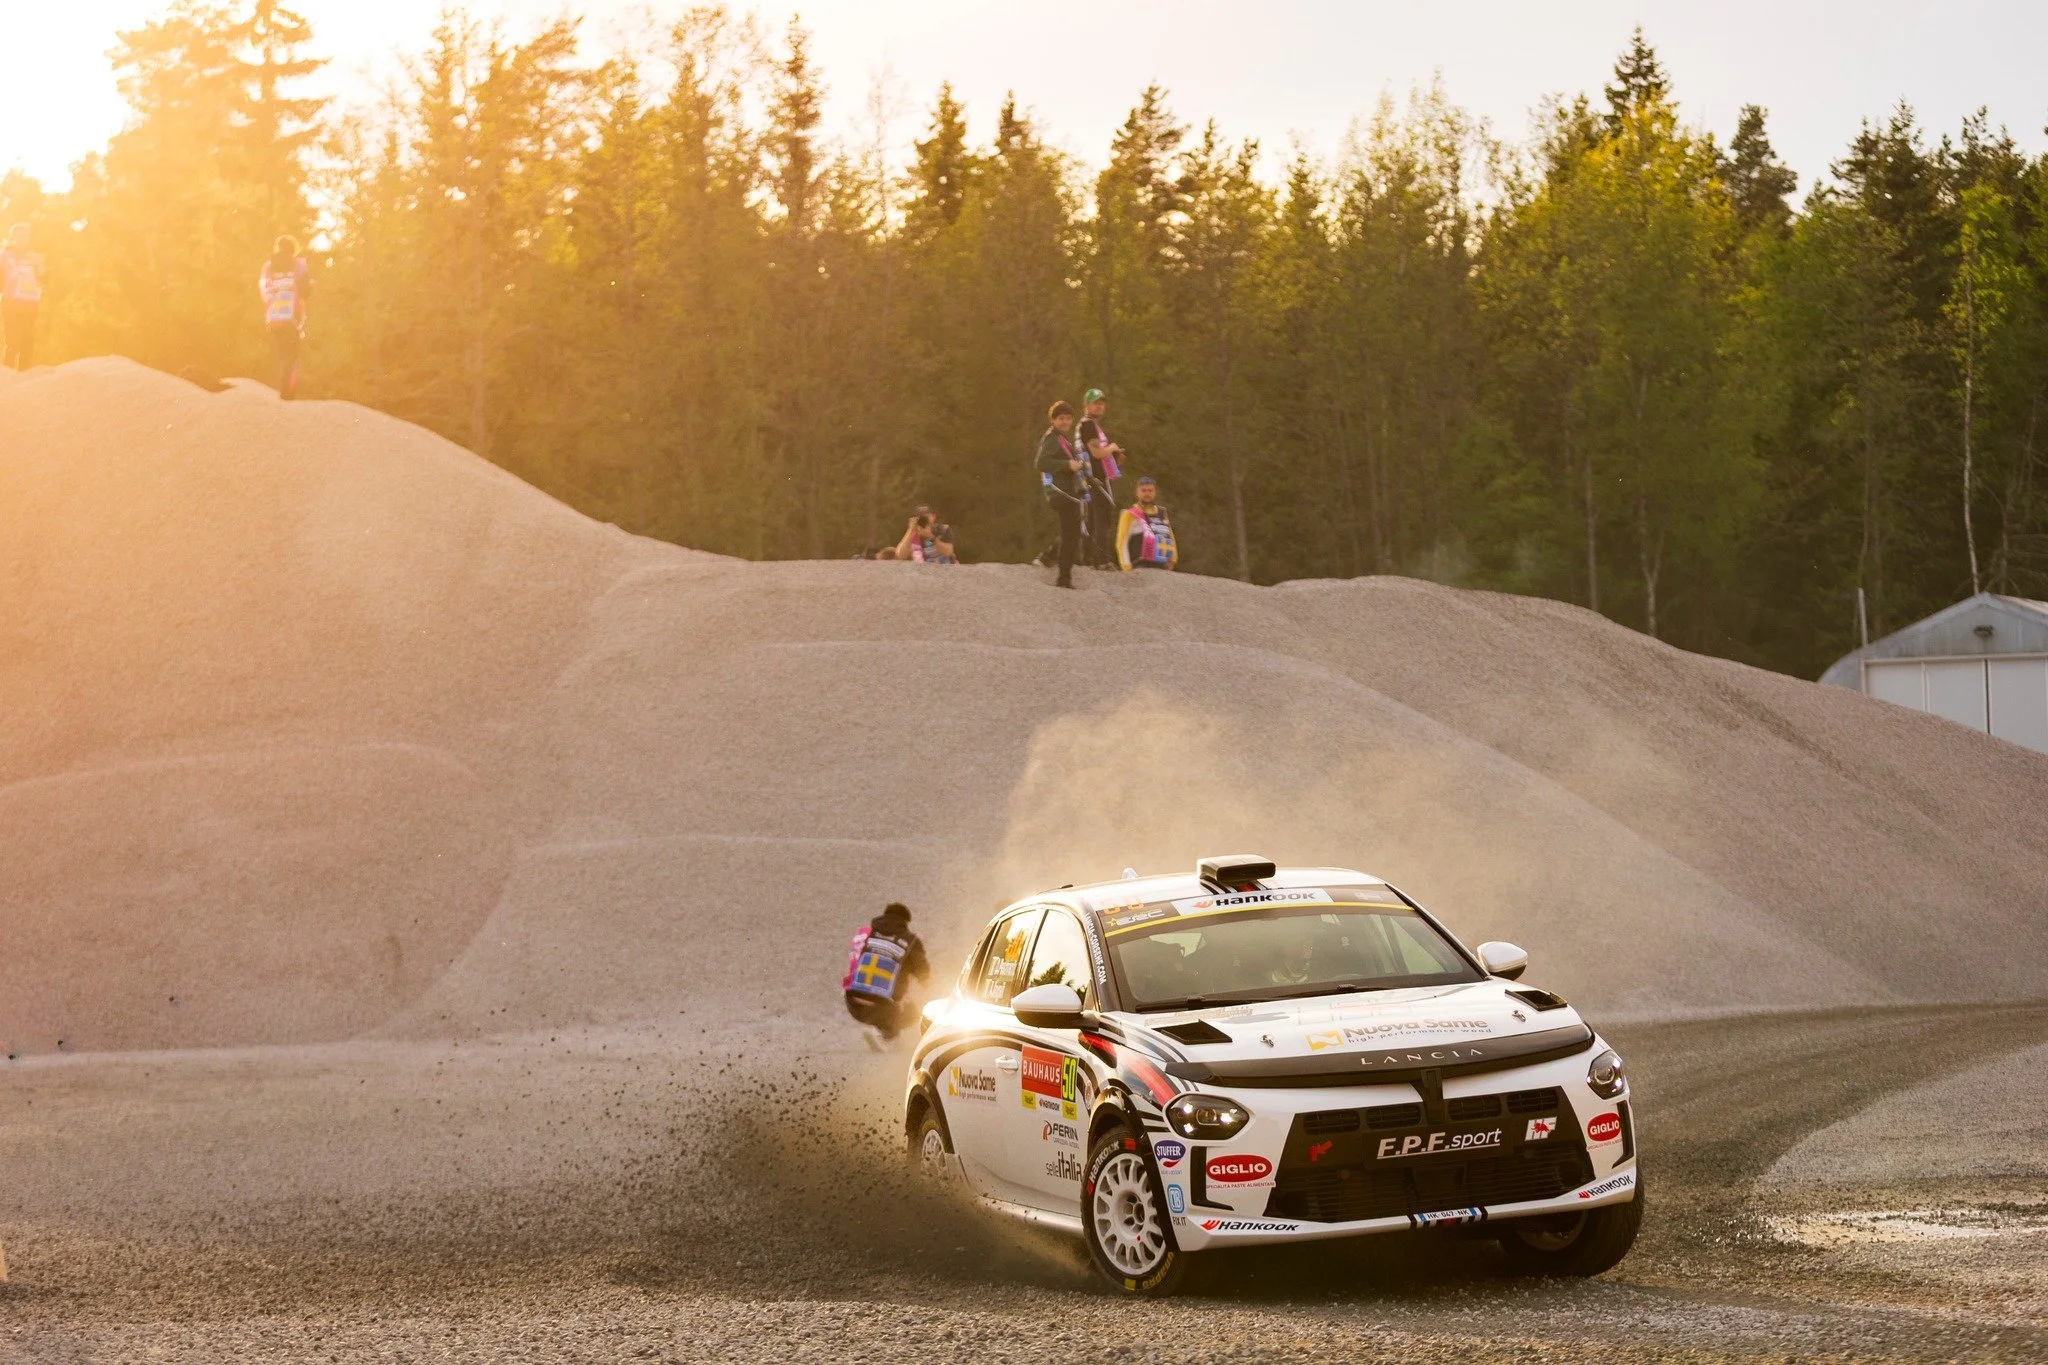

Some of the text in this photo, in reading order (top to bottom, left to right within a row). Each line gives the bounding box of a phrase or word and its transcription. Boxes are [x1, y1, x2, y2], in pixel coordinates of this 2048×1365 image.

[1343, 1018, 1488, 1038] Nuova Same
[1348, 1035, 1374, 1043] high
[1380, 1029, 1455, 1039] performance
[1361, 1048, 1483, 1065] LANCIA
[959, 1067, 996, 1092] Nuova Same
[1022, 1056, 1077, 1100] BAUHAUS 50
[1053, 1122, 1079, 1141] PERIN
[1589, 1120, 1620, 1135] GIGLIO
[1156, 1145, 1181, 1157] STUFFER
[1209, 1163, 1267, 1175] GIGLIO
